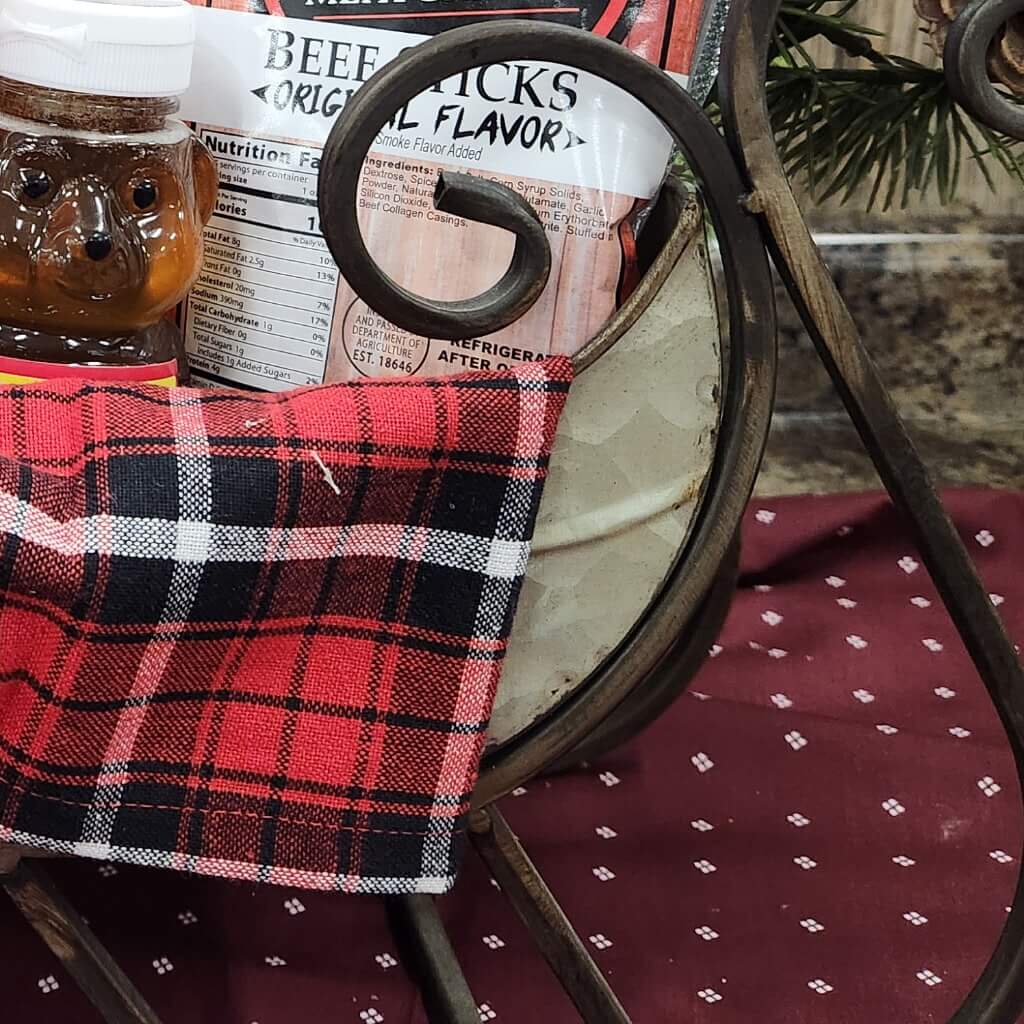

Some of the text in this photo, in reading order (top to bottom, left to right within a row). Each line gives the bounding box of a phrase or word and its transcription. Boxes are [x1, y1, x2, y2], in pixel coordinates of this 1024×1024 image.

[264, 27, 381, 83] BEEF
[434, 105, 565, 152] FLAVOR
[205, 136, 291, 165] Nutrition
[376, 132, 483, 161] Smoke Flavor Added
[220, 162, 309, 184] servings per container
[365, 156, 434, 175] Ingredients:
[233, 176, 248, 184] size
[517, 181, 546, 197] Syrup
[359, 198, 469, 228] Beef Collagen Casings.
[237, 252, 248, 264] Fat
[249, 256, 265, 268] 2.5g
[190, 287, 244, 309] Sodium 390mg
[235, 282, 255, 296] 20mg
[190, 301, 207, 313] Total
[208, 306, 259, 327] Carbohydrate
[356, 315, 374, 327] AND
[194, 317, 217, 332] Dietary
[219, 323, 235, 336] Fiber
[352, 326, 407, 347] DEPARTMENT
[193, 331, 232, 352] Total Sugars
[356, 339, 413, 359] AGRICULTURE
[197, 346, 224, 362] Includes
[236, 356, 262, 373] Added
[263, 364, 291, 380] Sugars
[353, 349, 413, 373] EST. 18646
[438, 350, 491, 370] AFTER
